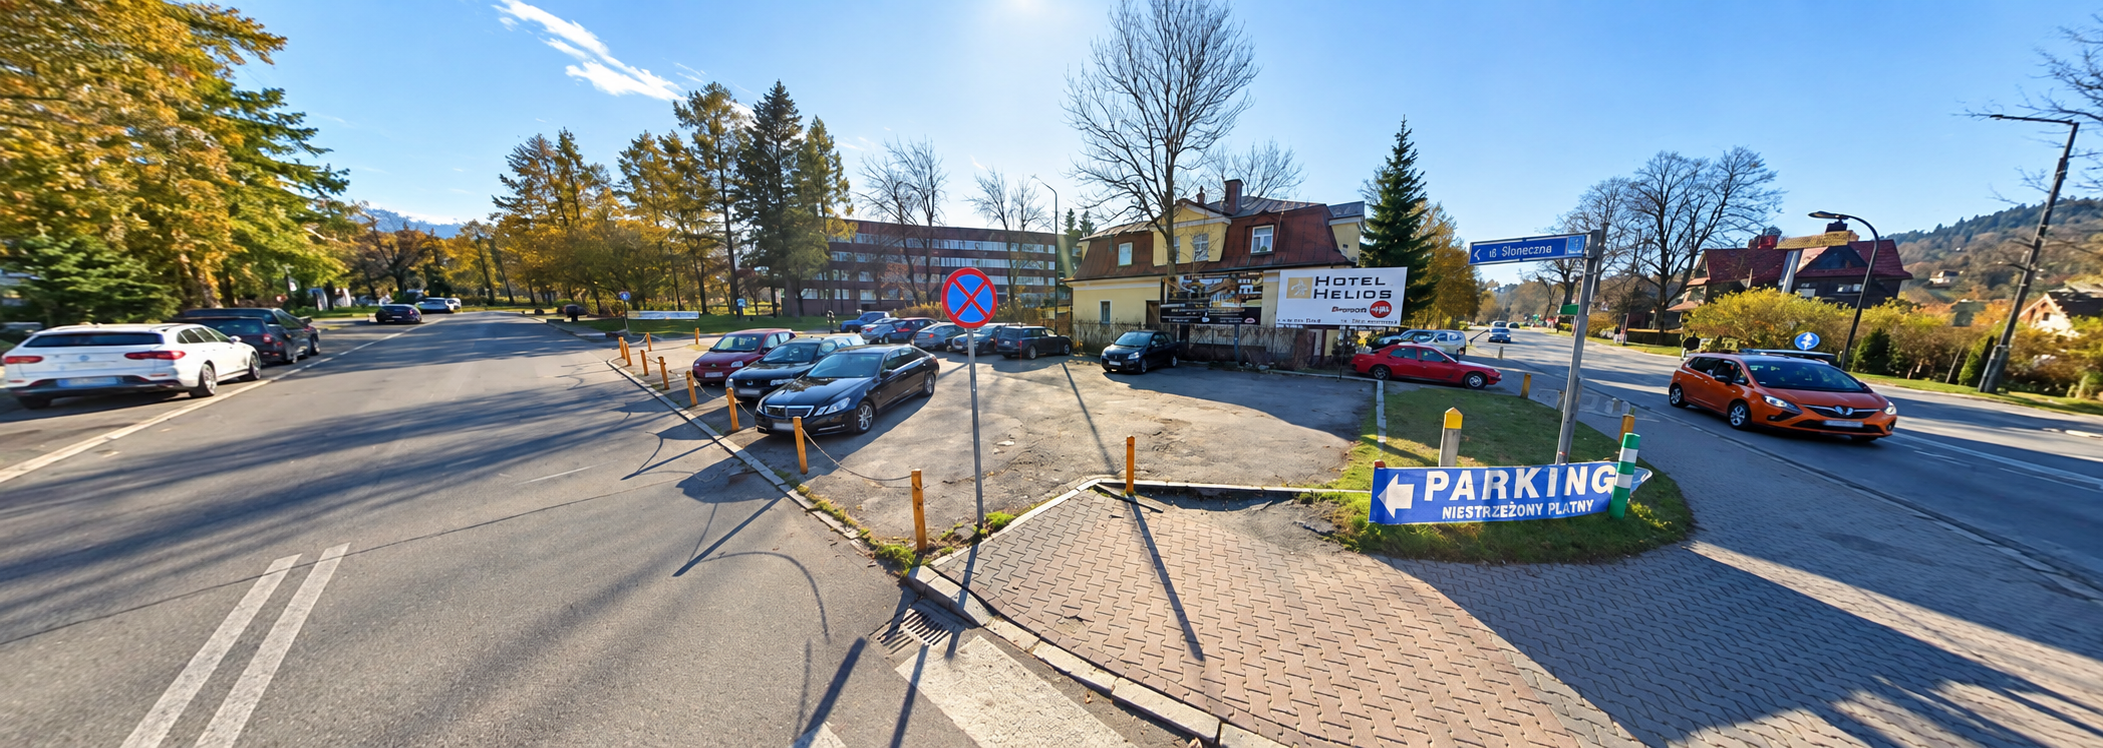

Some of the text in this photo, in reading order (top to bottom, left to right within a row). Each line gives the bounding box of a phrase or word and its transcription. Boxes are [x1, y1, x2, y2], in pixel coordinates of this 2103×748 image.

[1315, 276, 1386, 287] HOTEL
[1313, 289, 1392, 299] HELIOS
[1424, 465, 1616, 501] PARKING
[1442, 501, 1544, 520] NIESTRZEŻONY
